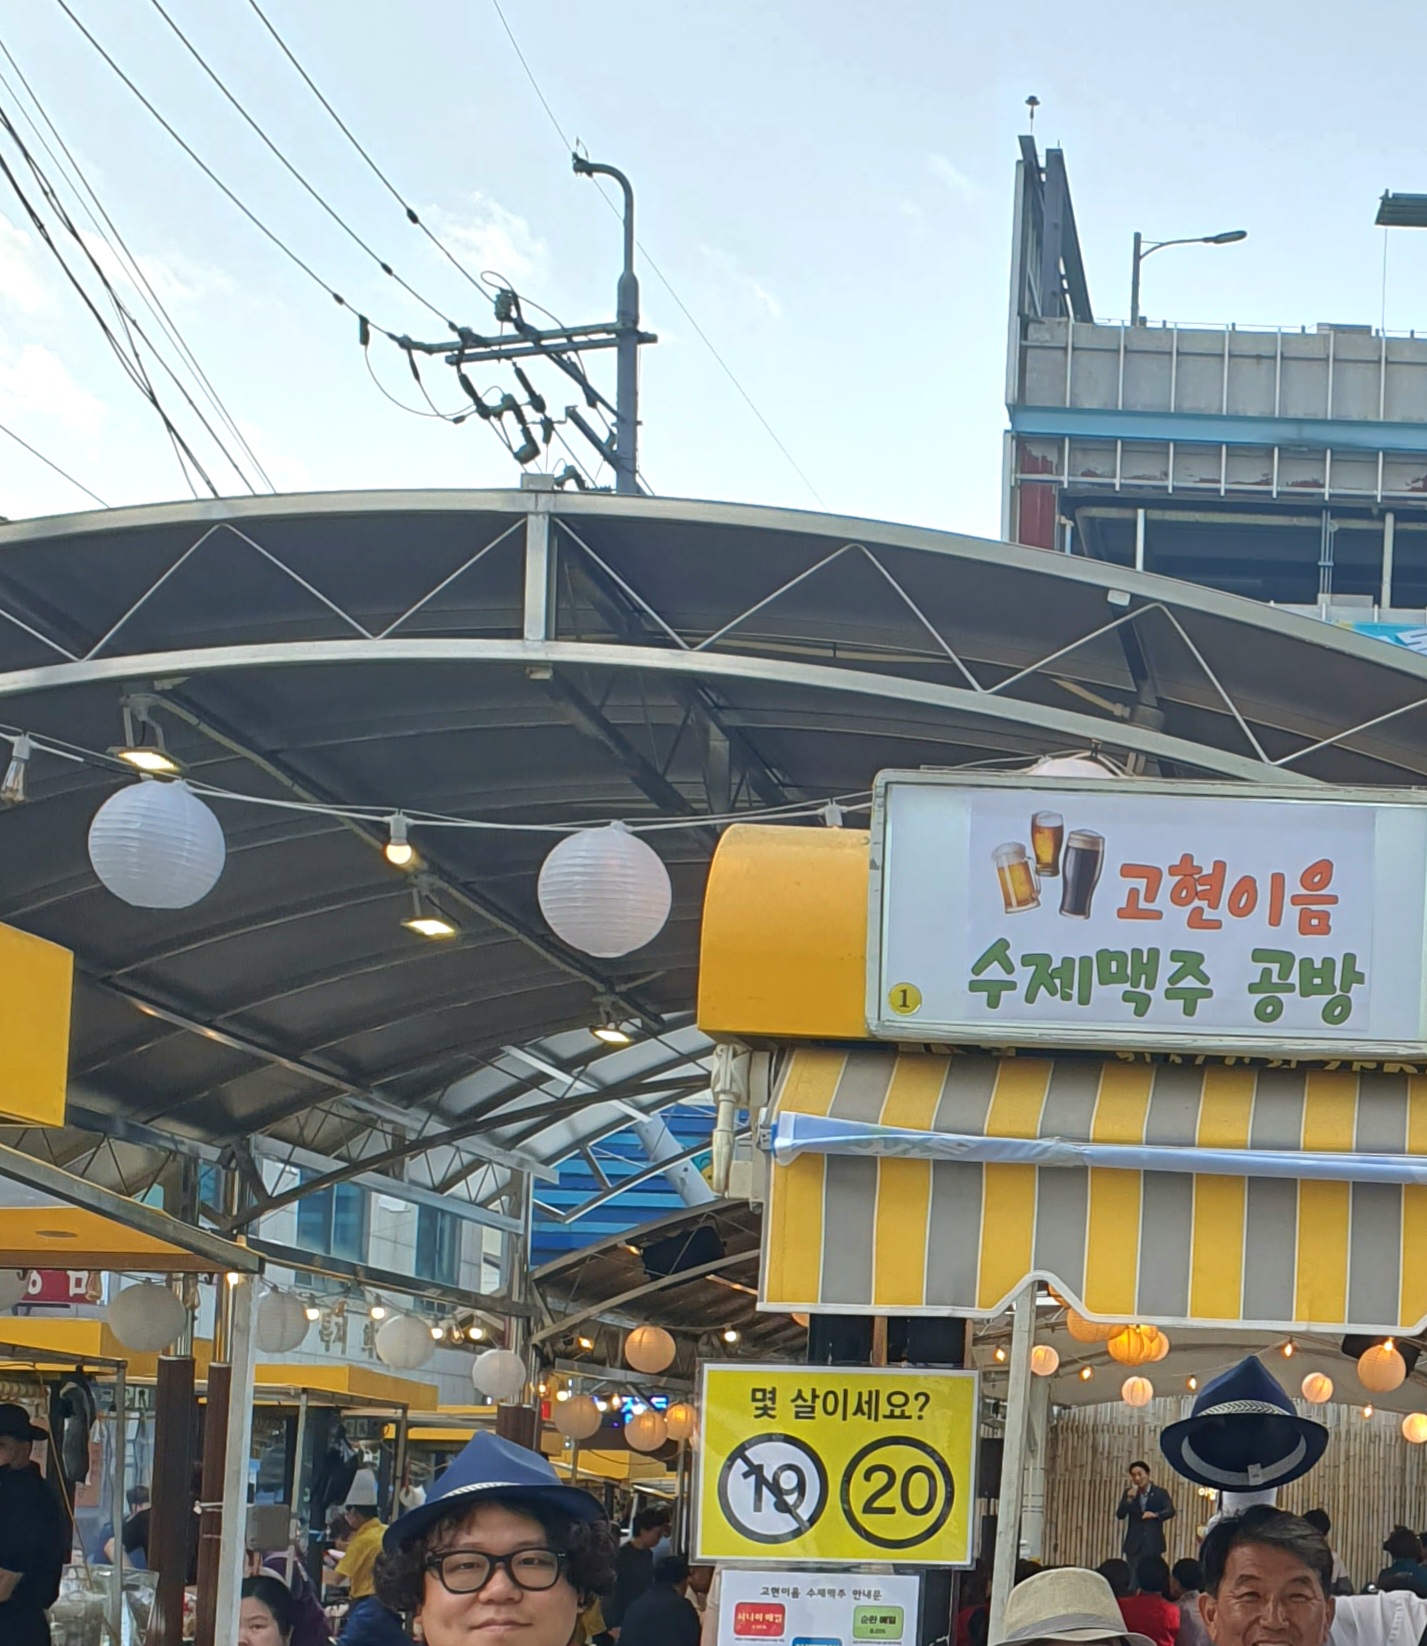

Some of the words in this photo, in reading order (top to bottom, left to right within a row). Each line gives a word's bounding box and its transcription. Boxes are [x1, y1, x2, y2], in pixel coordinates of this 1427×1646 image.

[1116, 853, 1340, 936] 고현이음
[968, 938, 1213, 1018] 수제맥주
[1248, 948, 1365, 1026] 공방
[751, 1387, 778, 1420] 몇
[790, 1388, 931, 1422] 살이세요?
[861, 1463, 938, 1517] 20
[760, 1586, 800, 1599] 고현이음
